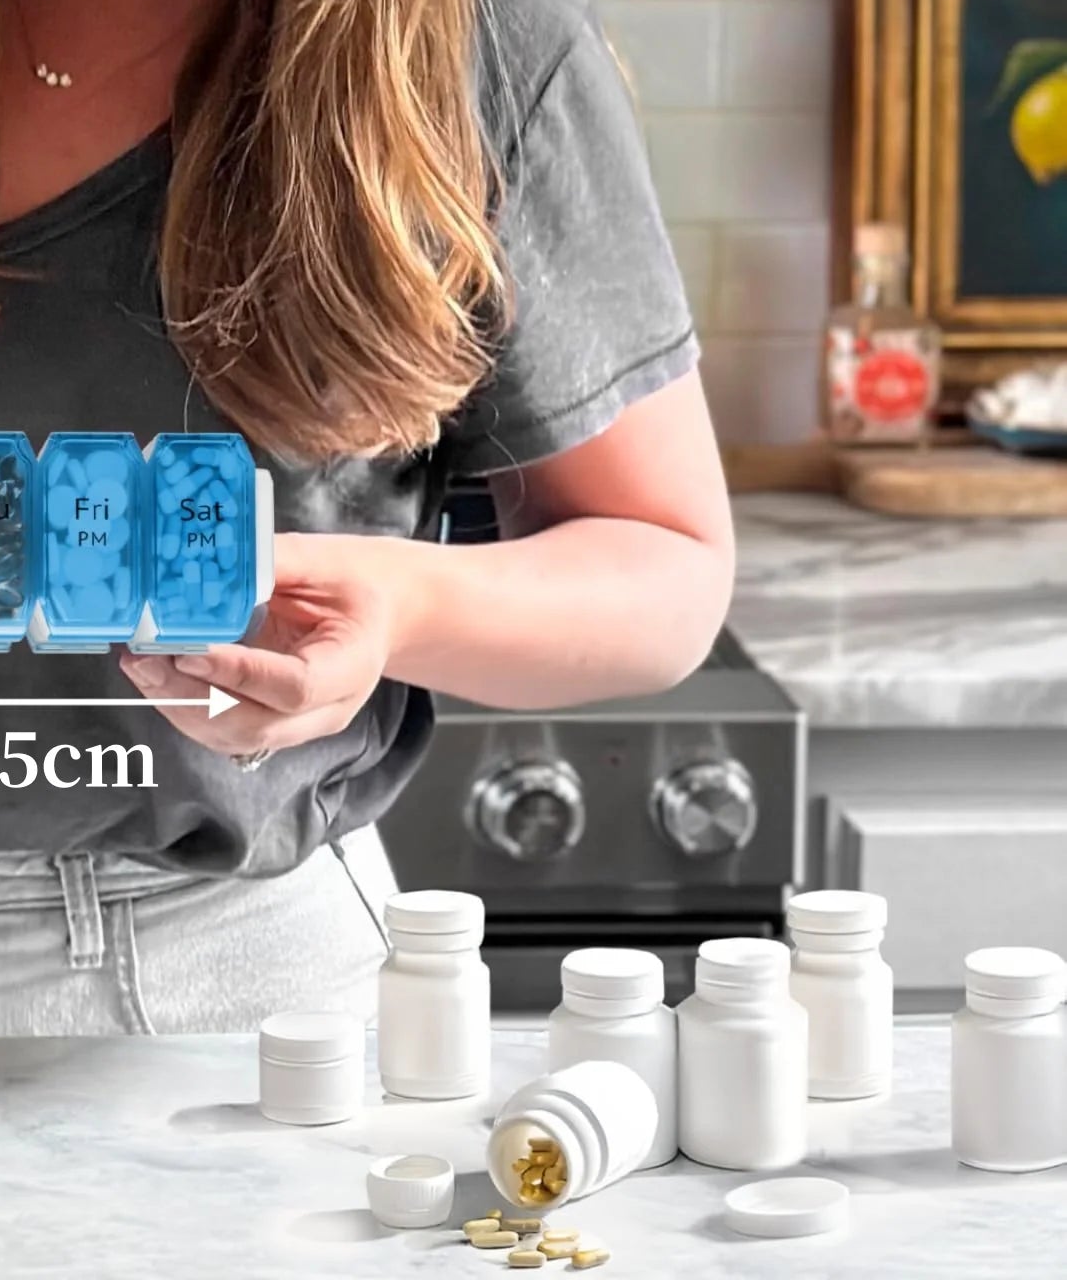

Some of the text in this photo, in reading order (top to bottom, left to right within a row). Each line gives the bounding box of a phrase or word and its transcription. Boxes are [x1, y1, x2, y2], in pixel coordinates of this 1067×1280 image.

[74, 497, 109, 521] Fri
[179, 498, 225, 522] Sat
[78, 531, 108, 547] PM
[186, 532, 217, 548] PM
